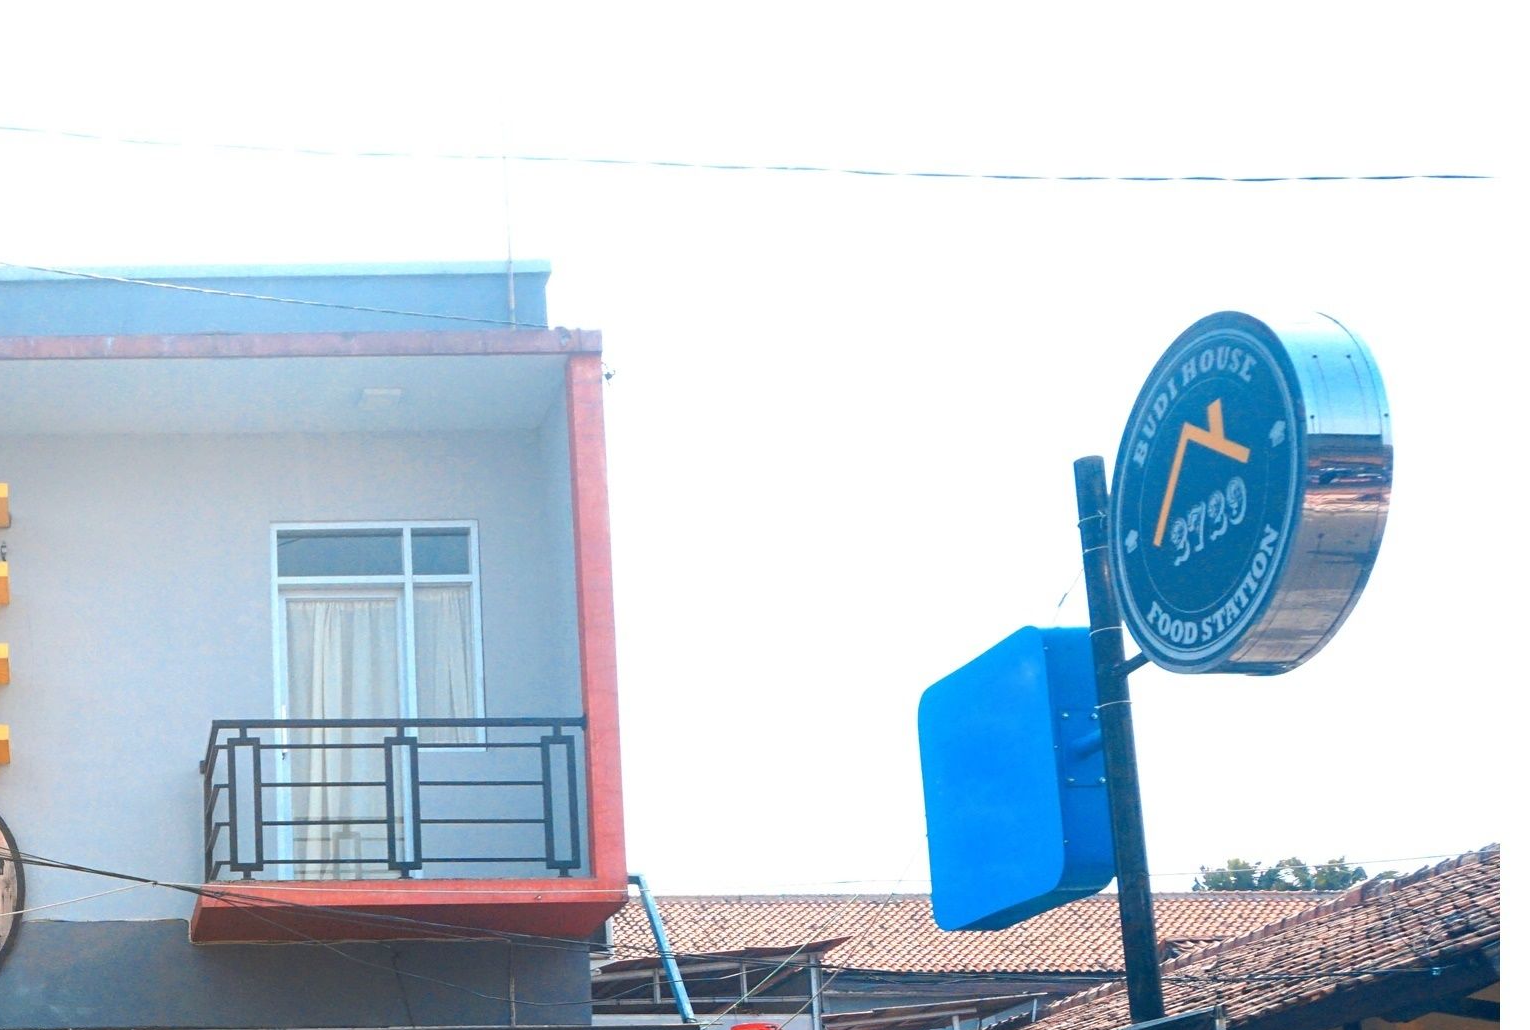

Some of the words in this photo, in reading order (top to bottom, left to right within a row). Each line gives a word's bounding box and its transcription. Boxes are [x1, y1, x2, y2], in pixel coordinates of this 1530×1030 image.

[1132, 376, 1179, 469] BUDI
[1181, 345, 1258, 387] HOUSE
[1171, 475, 1247, 567] 2729
[1145, 600, 1199, 645] FOOD
[1201, 523, 1279, 643] STATION
